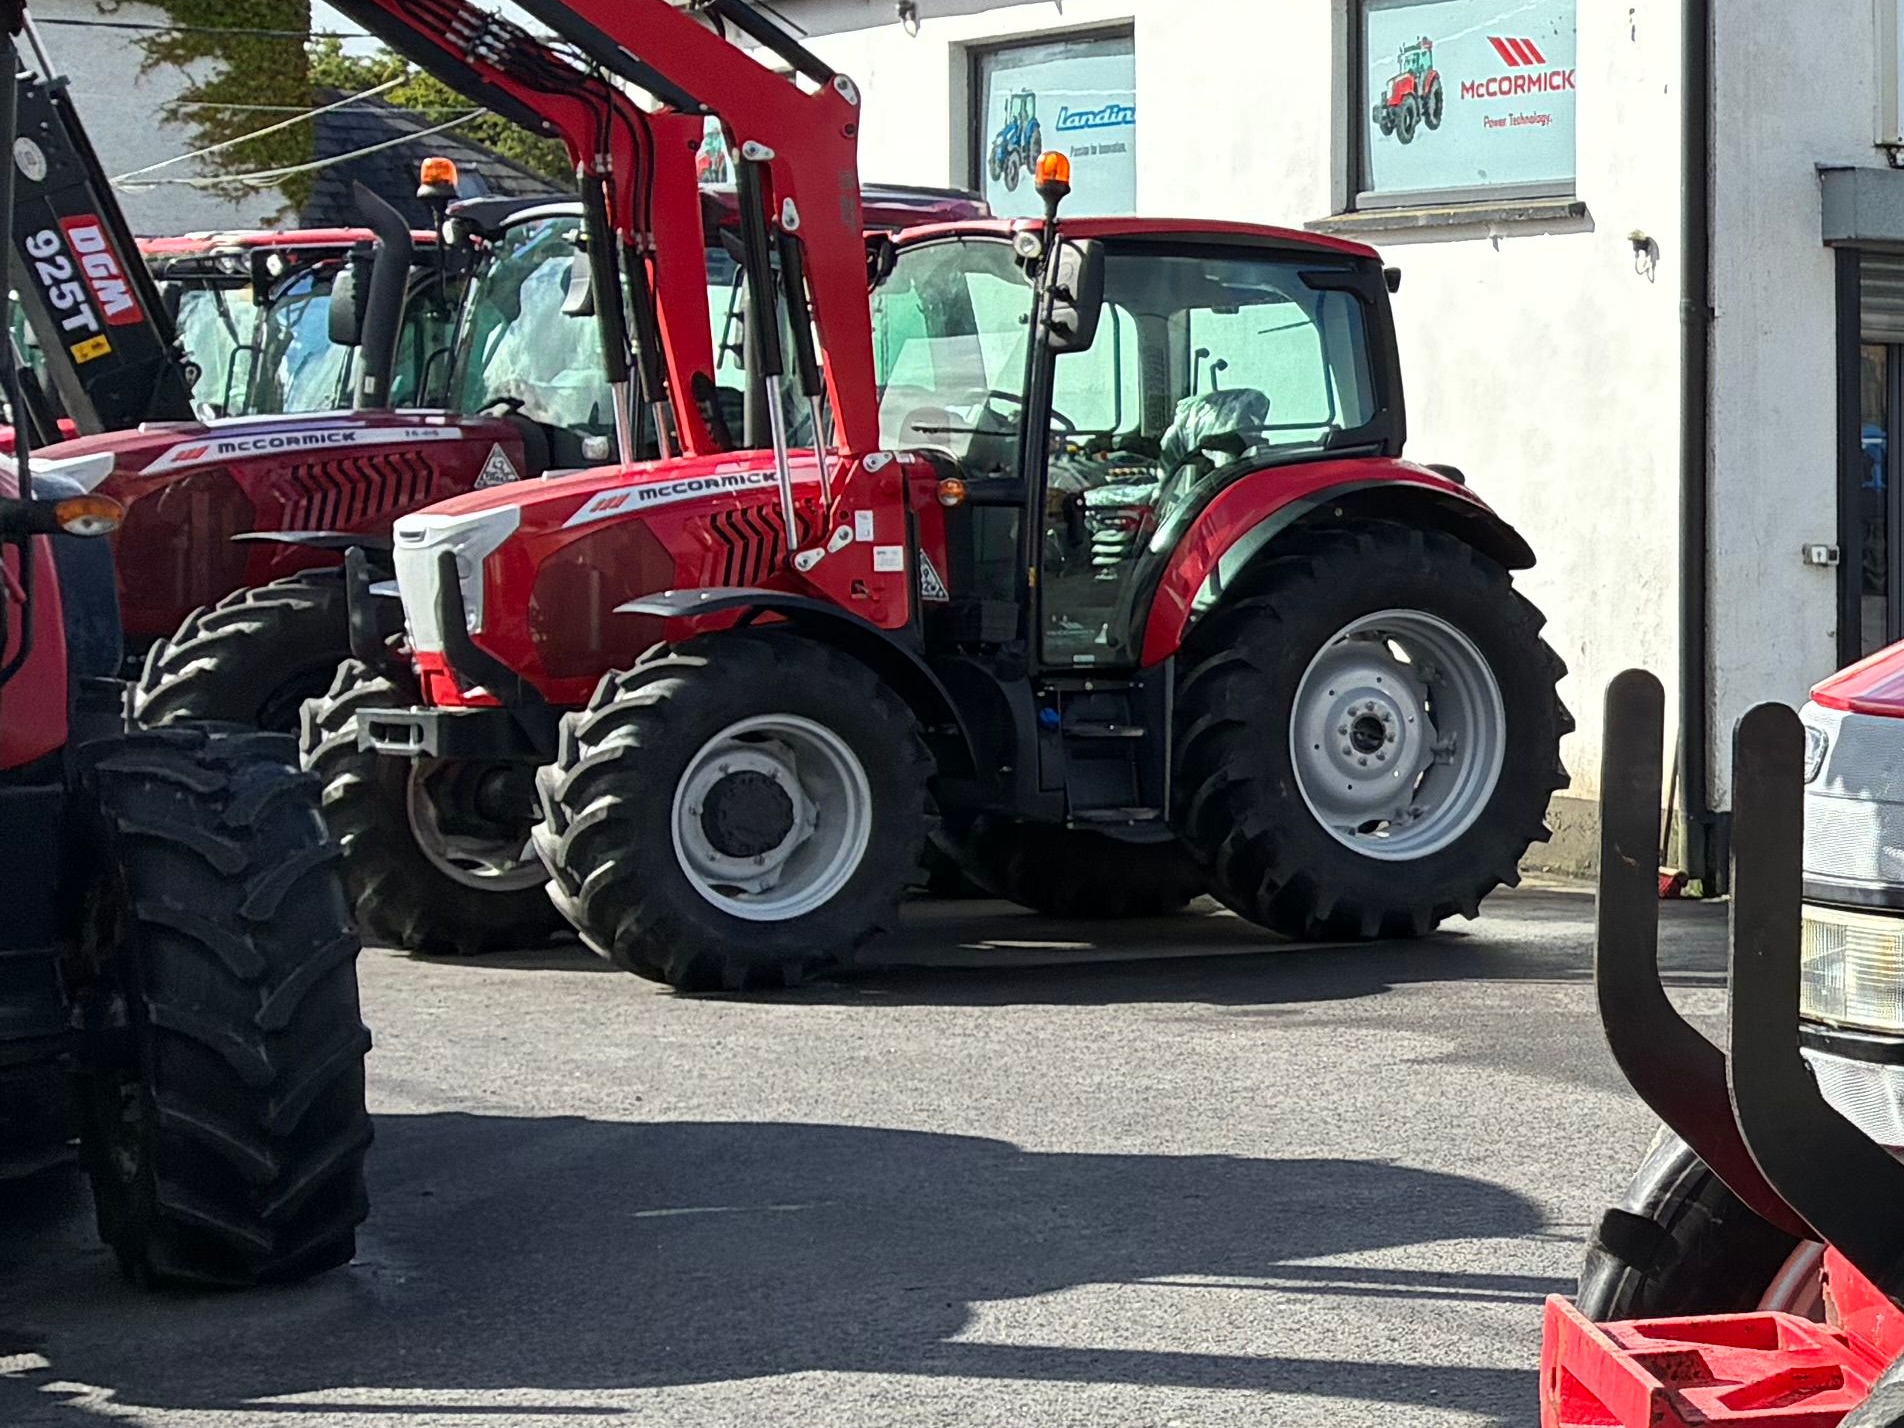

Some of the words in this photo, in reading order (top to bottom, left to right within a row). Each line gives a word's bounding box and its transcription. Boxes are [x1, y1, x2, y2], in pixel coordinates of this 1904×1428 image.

[1461, 70, 1576, 100] McCORMICK
[1483, 114, 1507, 129] Power
[25, 229, 100, 332] 925T
[68, 225, 134, 317] DGM
